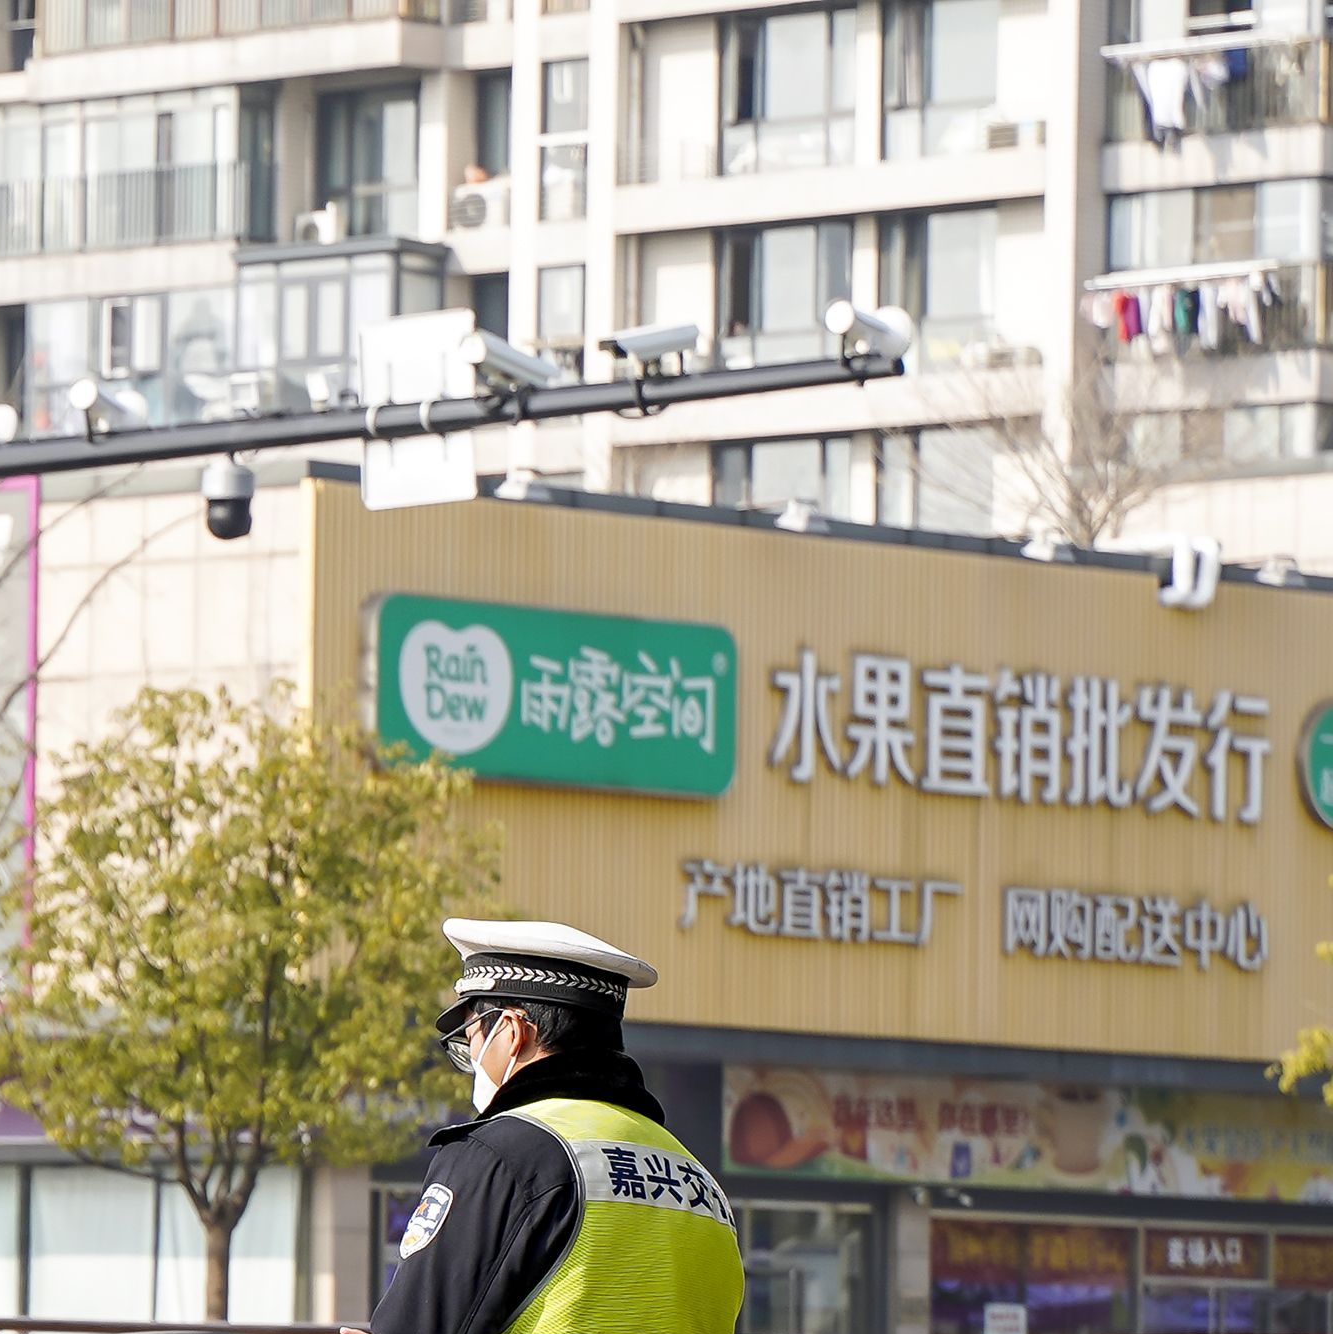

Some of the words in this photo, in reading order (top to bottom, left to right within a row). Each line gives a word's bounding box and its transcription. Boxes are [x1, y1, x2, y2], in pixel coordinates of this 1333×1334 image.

[425, 643, 487, 685] Rain
[426, 685, 488, 724] Dew
[521, 645, 715, 754] 雨露空间
[770, 648, 1272, 826] 水果直销批发行
[678, 859, 964, 947] 产地直销工厂
[1004, 886, 1269, 972] 网购配送中心
